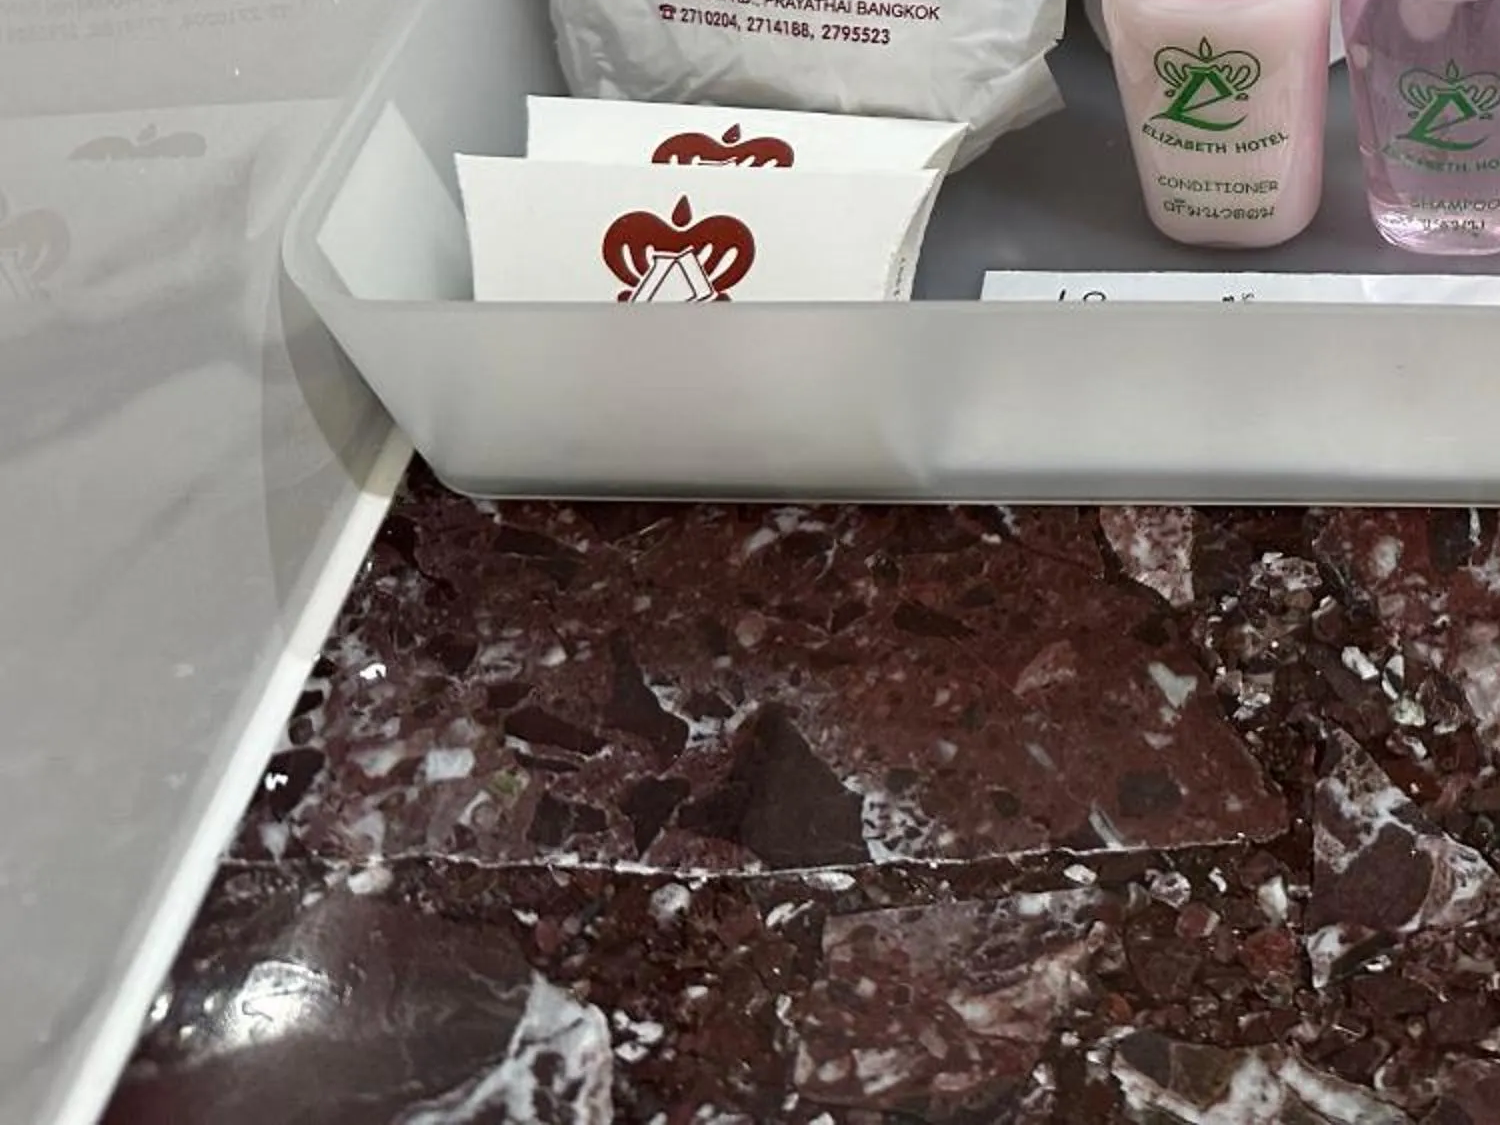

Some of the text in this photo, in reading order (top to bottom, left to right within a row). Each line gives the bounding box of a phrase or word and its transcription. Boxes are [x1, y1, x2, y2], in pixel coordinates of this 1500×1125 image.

[857, 0, 941, 20] BANGKOK
[680, 8, 891, 45] 2710204, 2714188, 2795523
[1142, 123, 1290, 154] ELIZABETH HOTEL
[1158, 175, 1279, 194] CONDITIONER
[1411, 197, 1500, 212] SHAMPOO
